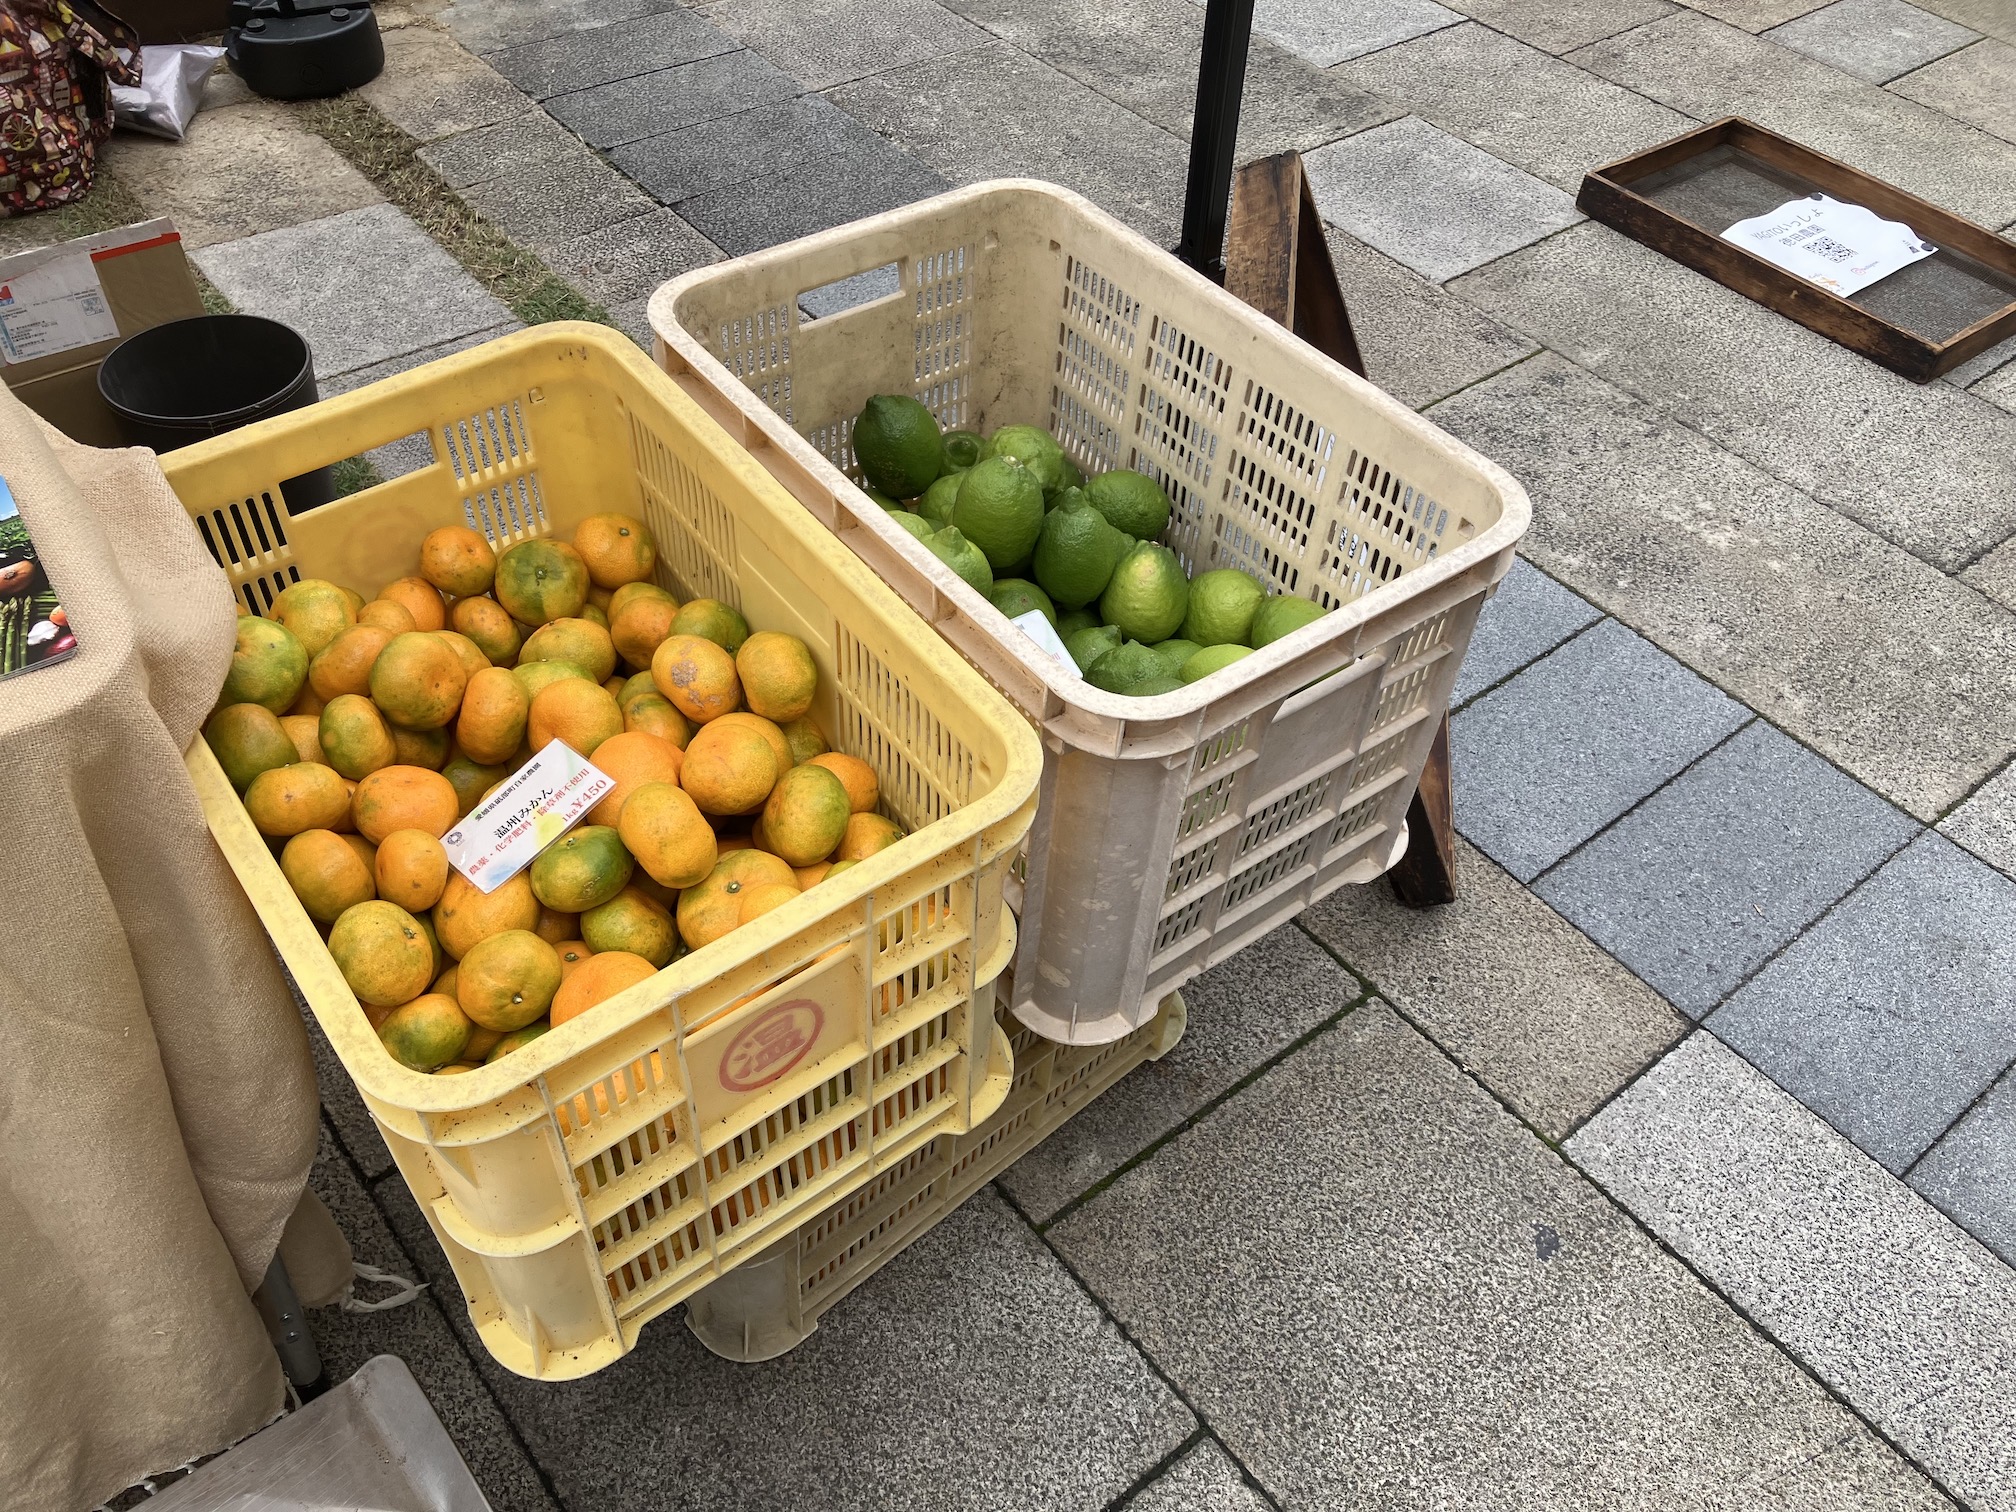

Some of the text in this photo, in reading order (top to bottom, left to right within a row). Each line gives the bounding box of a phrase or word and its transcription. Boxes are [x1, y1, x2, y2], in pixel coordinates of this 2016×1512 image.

[493, 787, 554, 839] 温州みかん
